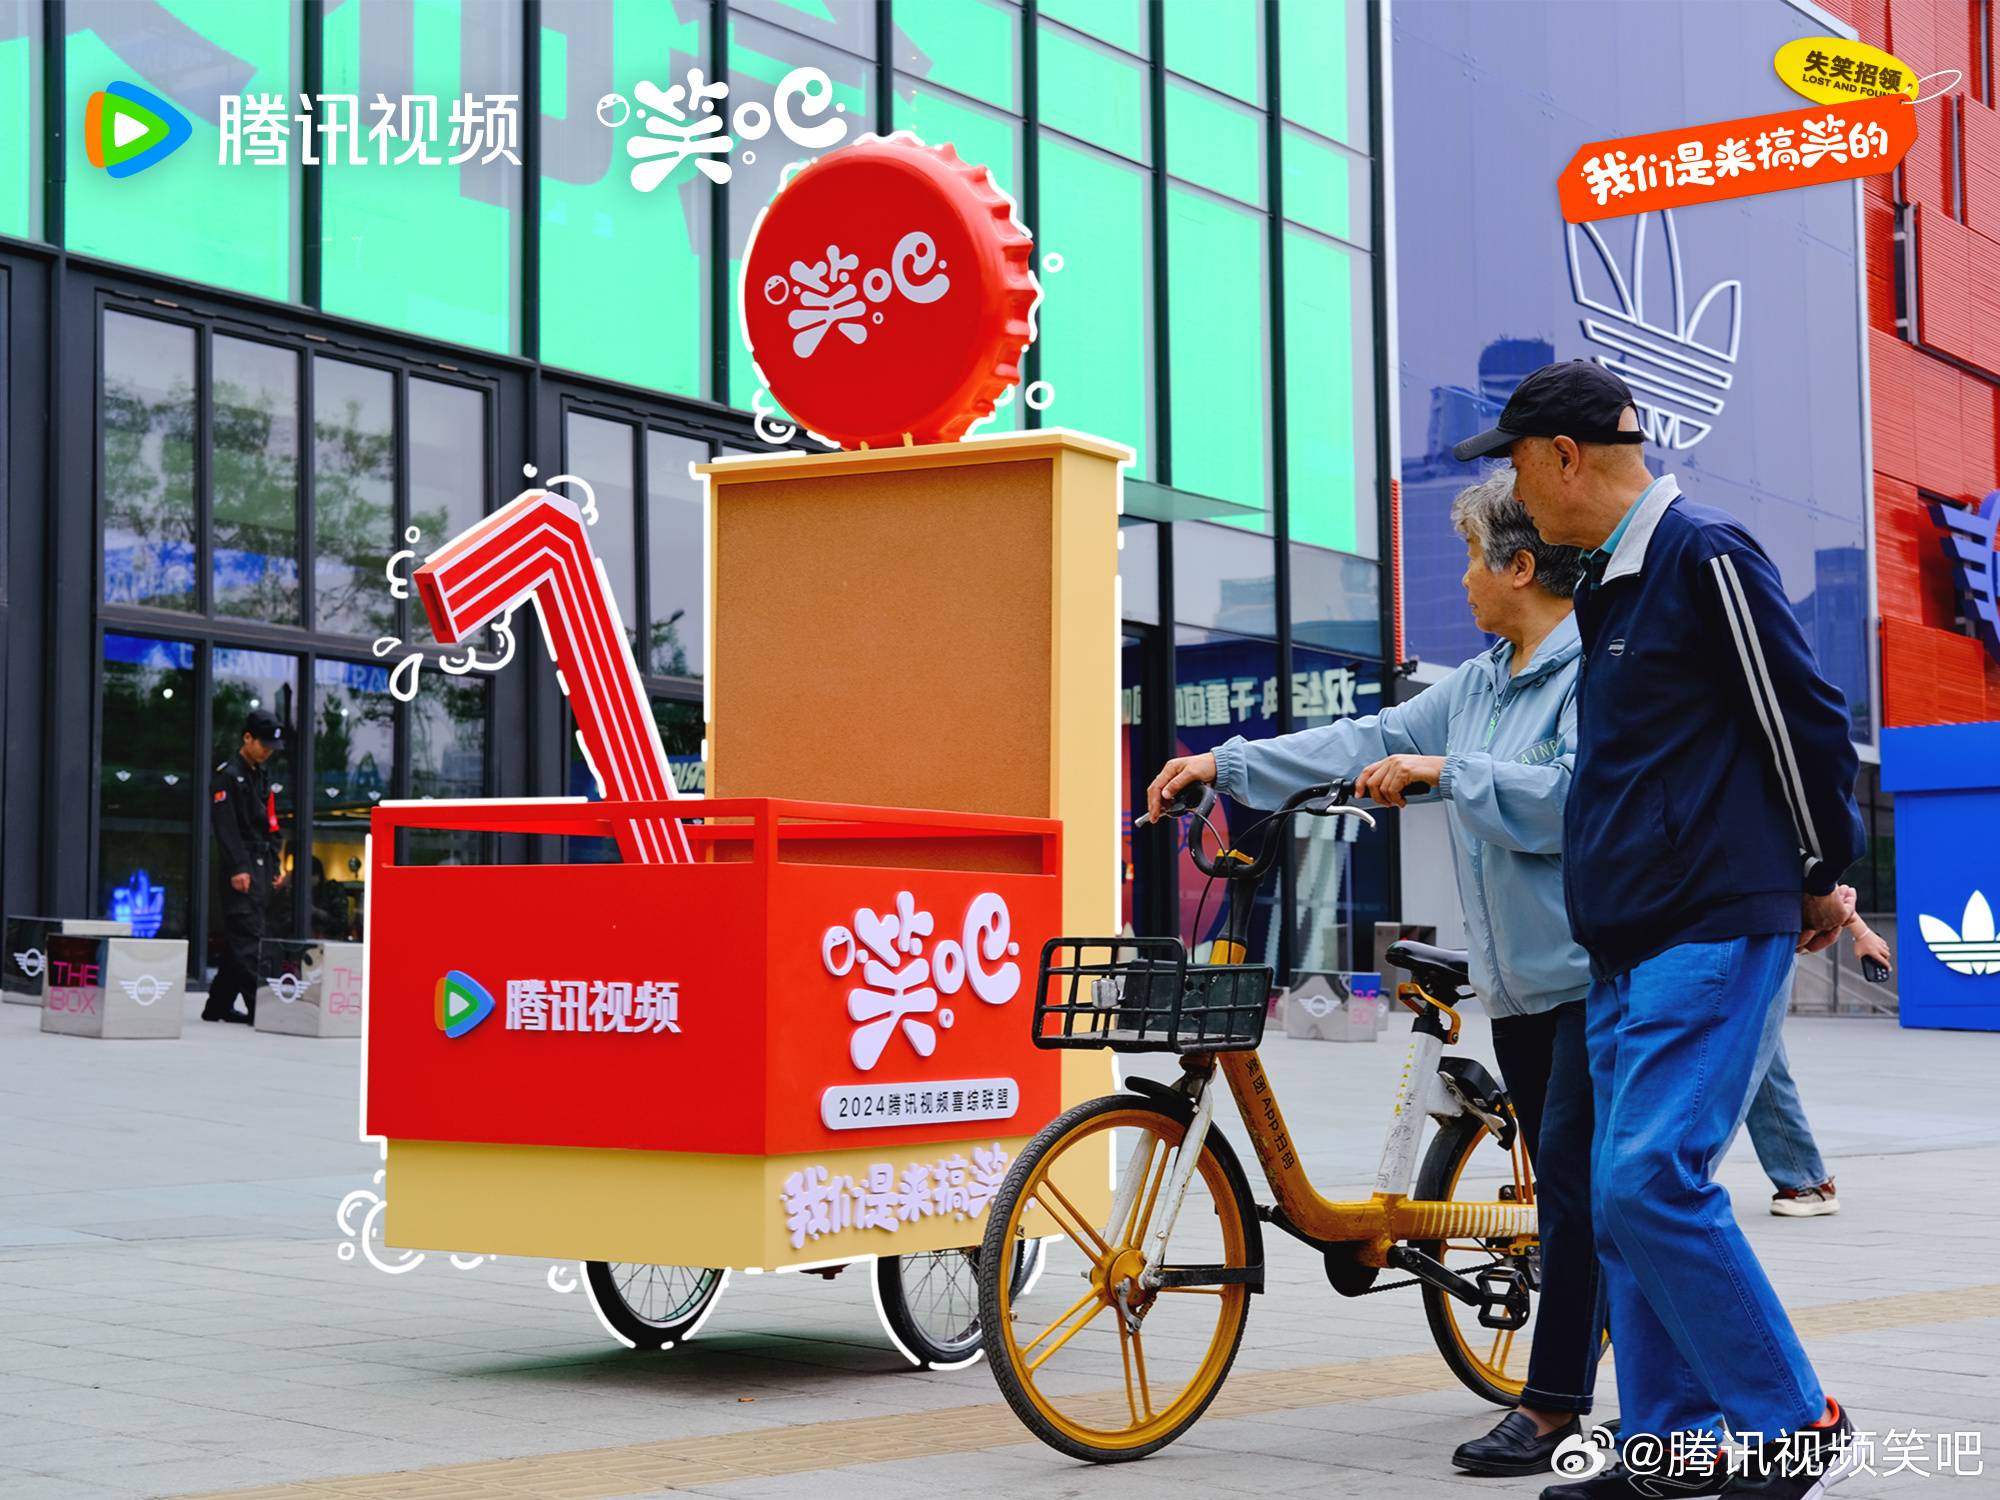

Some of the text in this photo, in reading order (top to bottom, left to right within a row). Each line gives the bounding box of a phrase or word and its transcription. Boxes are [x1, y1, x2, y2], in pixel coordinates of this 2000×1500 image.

[787, 231, 951, 359] 笑吧
[50, 987, 97, 1015] BOX
[53, 960, 100, 988] THE
[847, 891, 1021, 1071] 笑吧
[505, 979, 682, 1034] 腾讯视频
[839, 1088, 1009, 1119] 2024腾讯视频喜综联盟
[780, 1142, 1037, 1249] 我们是来搞笑
